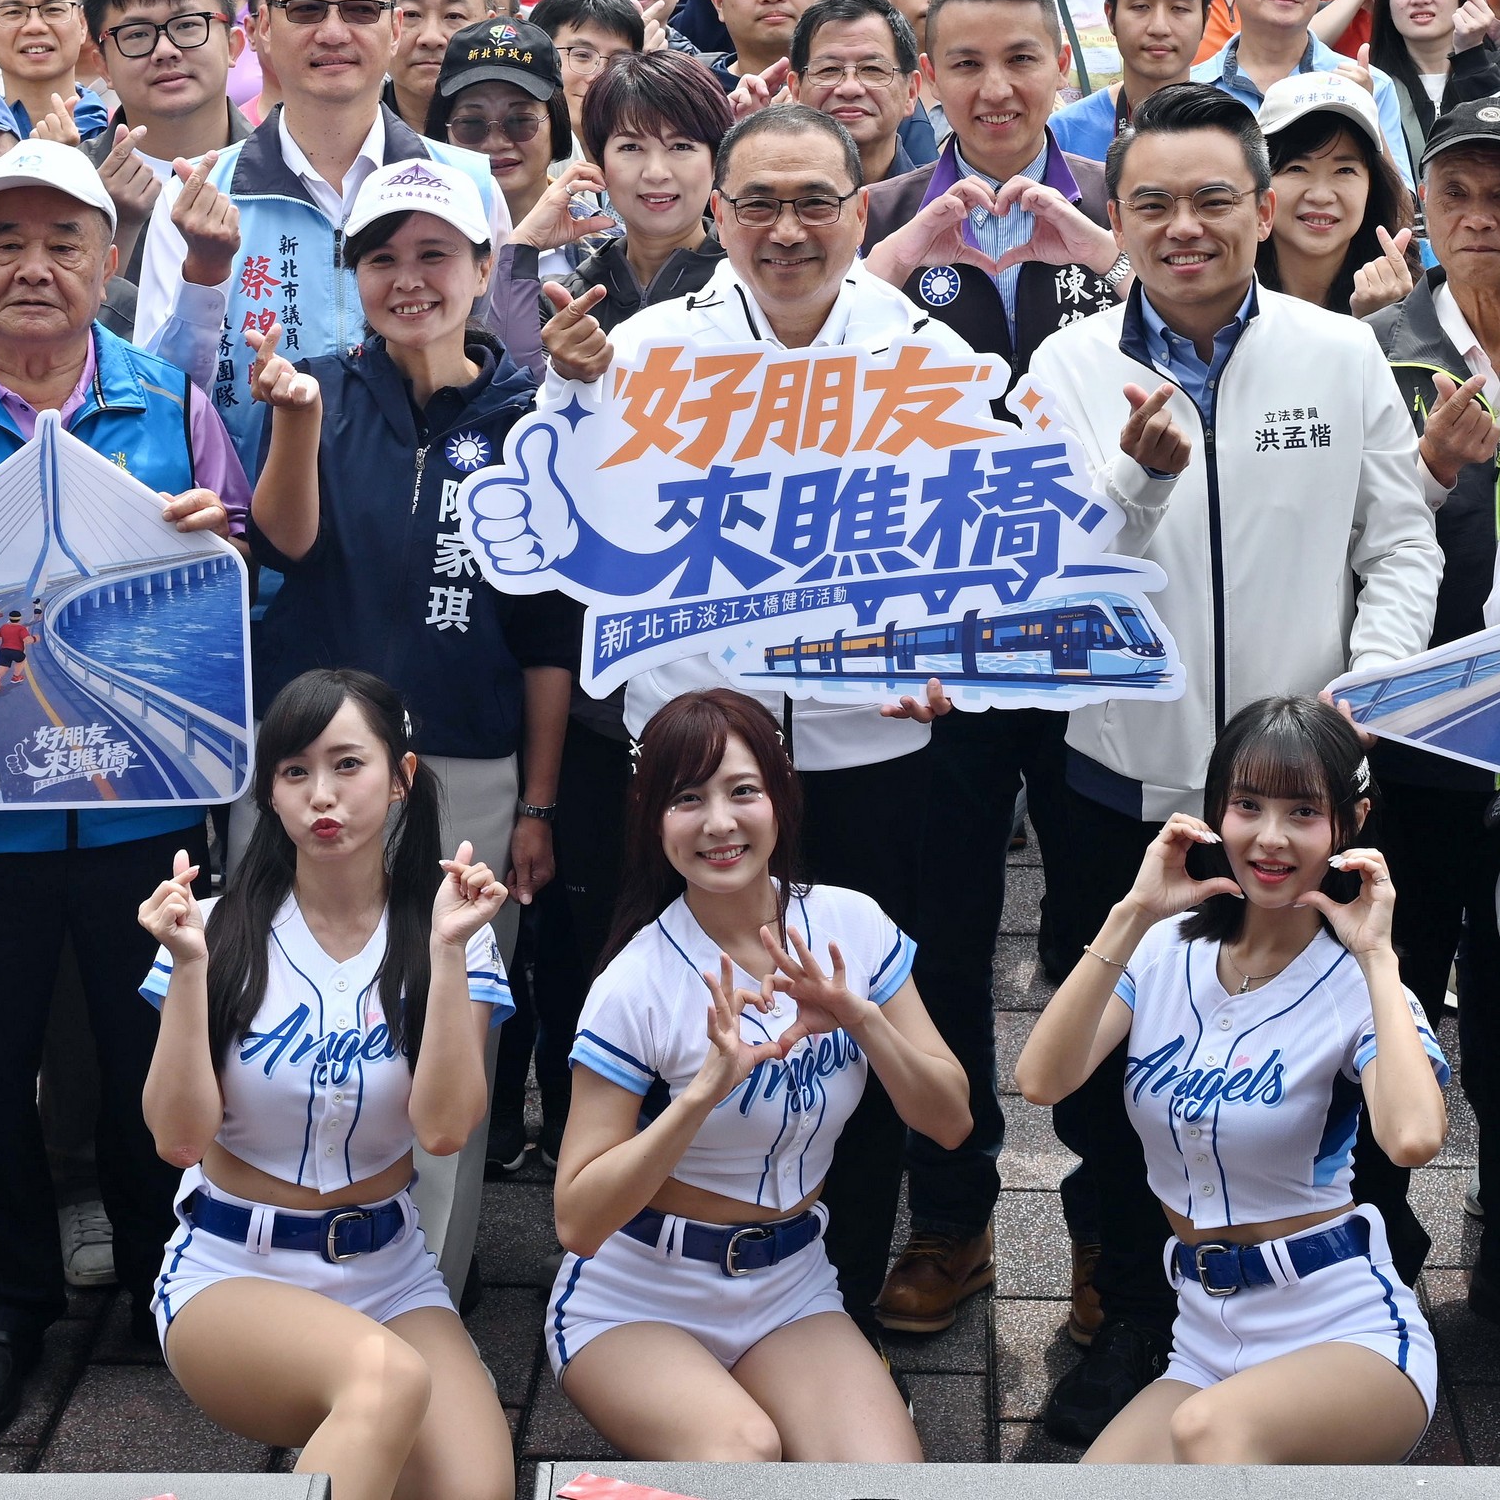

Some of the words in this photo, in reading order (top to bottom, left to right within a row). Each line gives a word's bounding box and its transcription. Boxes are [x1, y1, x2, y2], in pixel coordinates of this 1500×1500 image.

[467, 47, 533, 66] 新北市政府
[387, 174, 443, 188] 2026
[278, 234, 303, 351] 新北市議員
[1254, 422, 1332, 453] 洪孟楷
[1264, 407, 1319, 424] 立法委員
[655, 443, 1093, 600] 來瞧橋
[599, 585, 848, 659] 新北市淡江大橋健行活動
[31, 723, 116, 753] 好朋友
[239, 1002, 408, 1086] Ange
[1124, 1034, 1285, 1123] Angels
